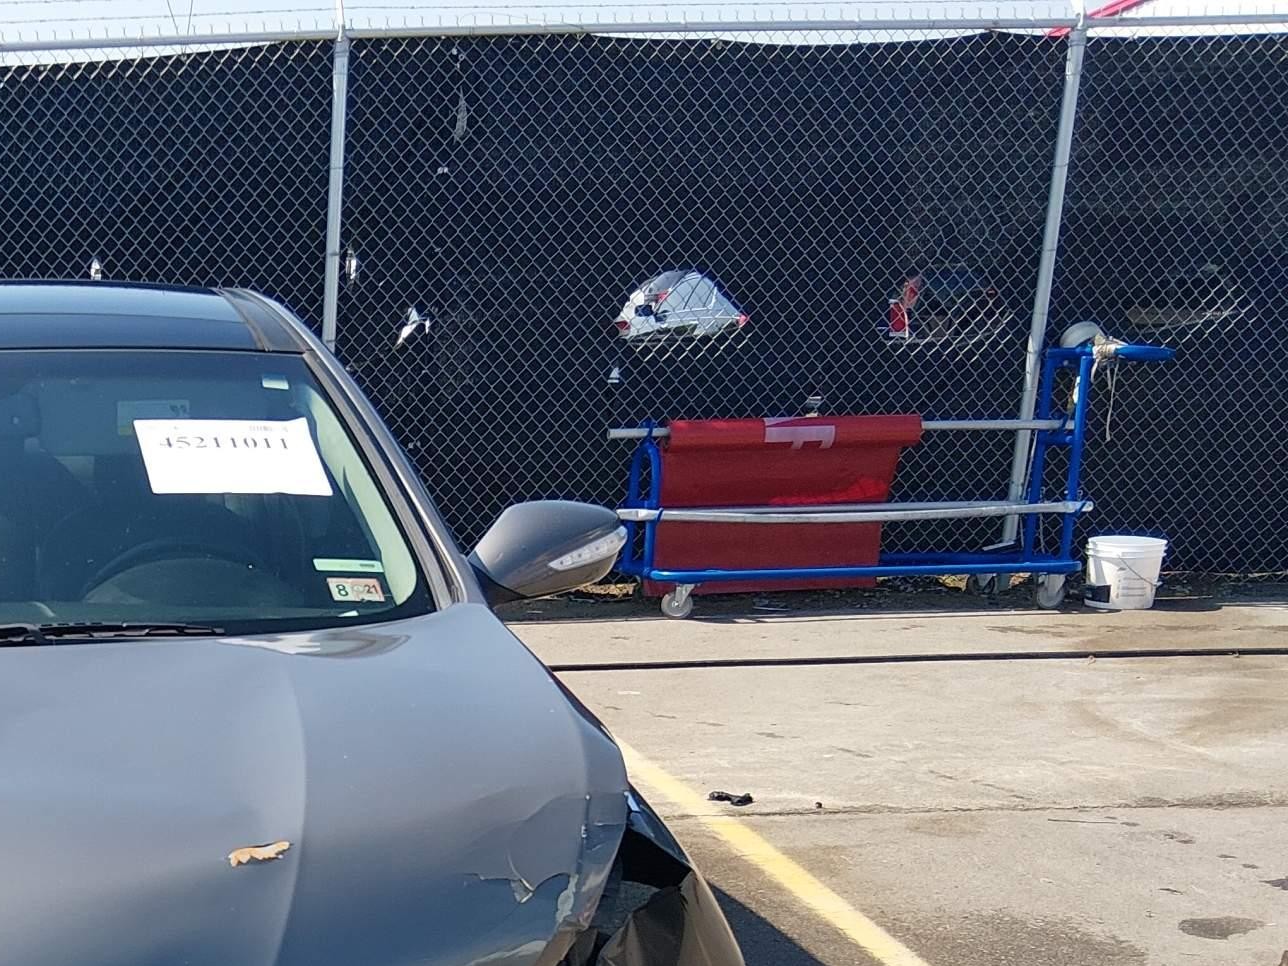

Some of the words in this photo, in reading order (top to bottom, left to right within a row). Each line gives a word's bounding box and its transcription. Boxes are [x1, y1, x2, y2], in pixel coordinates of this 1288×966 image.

[159, 436, 290, 449] 45211011
[336, 584, 349, 597] 8
[364, 584, 379, 594] 21
